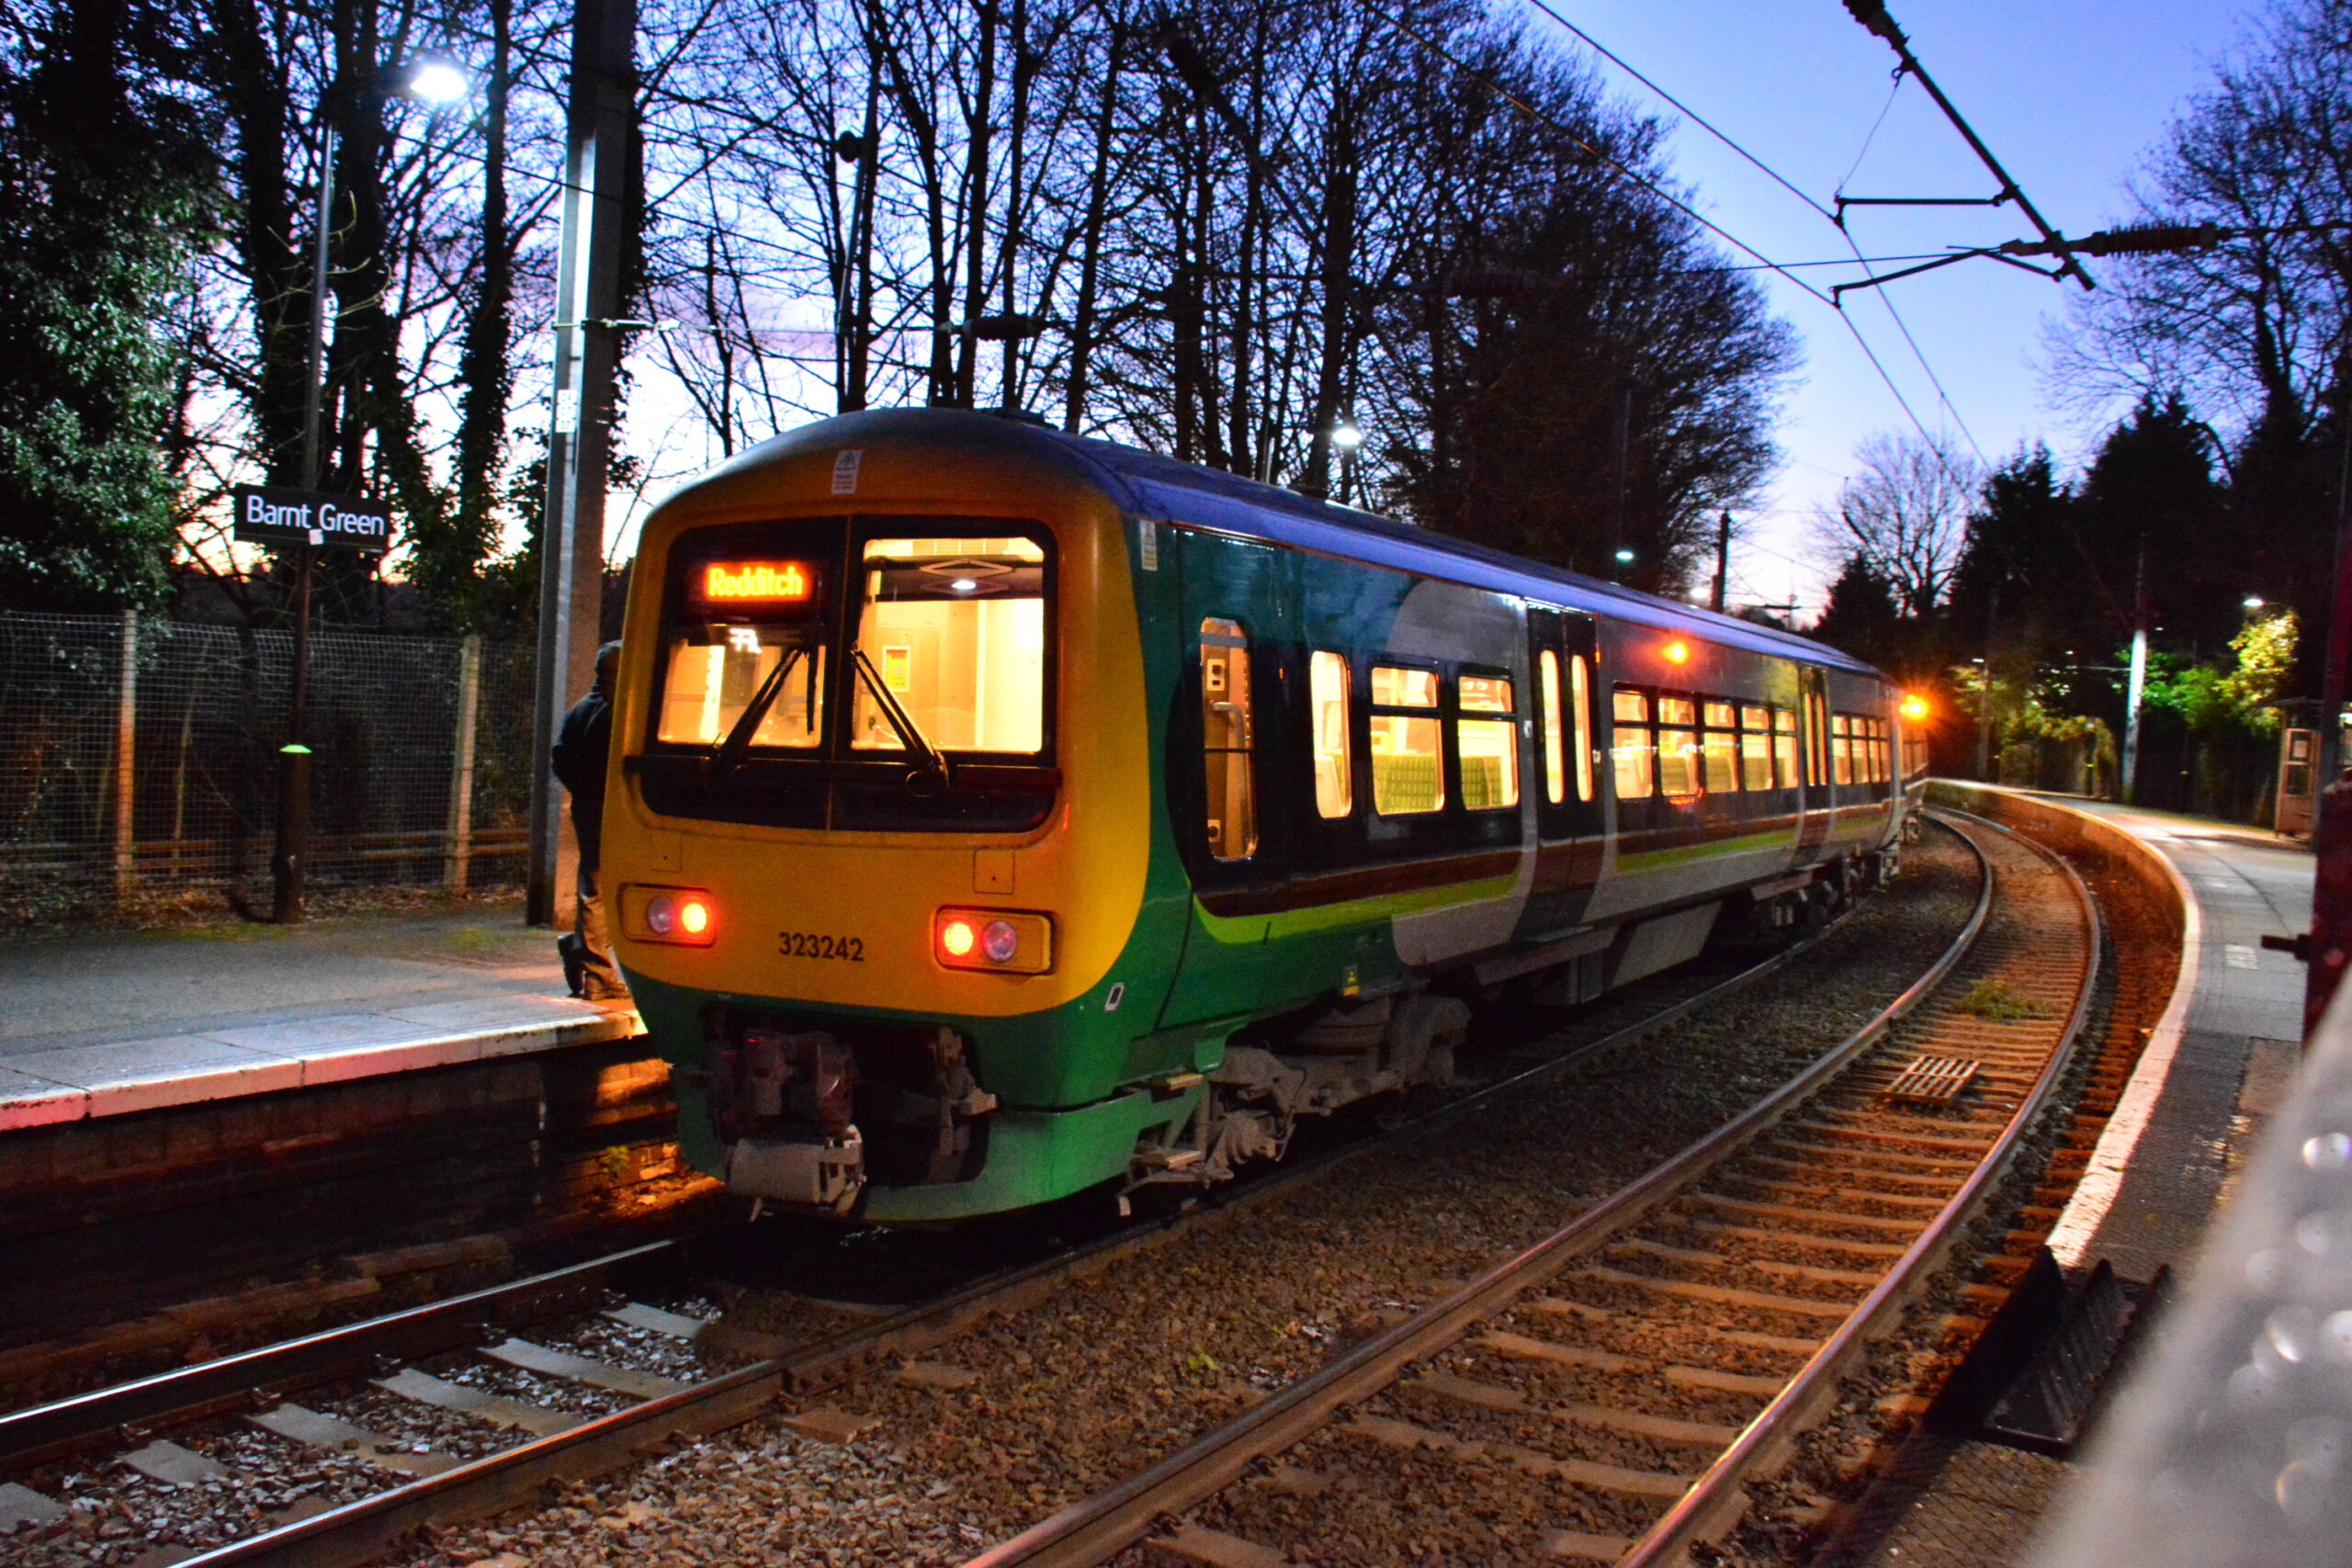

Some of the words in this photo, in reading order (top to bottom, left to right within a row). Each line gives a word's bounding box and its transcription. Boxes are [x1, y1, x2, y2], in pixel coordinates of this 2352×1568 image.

[246, 494, 312, 529] Barnt
[318, 502, 385, 536] Green
[707, 565, 804, 597] Redditch
[778, 931, 865, 962] 323242
